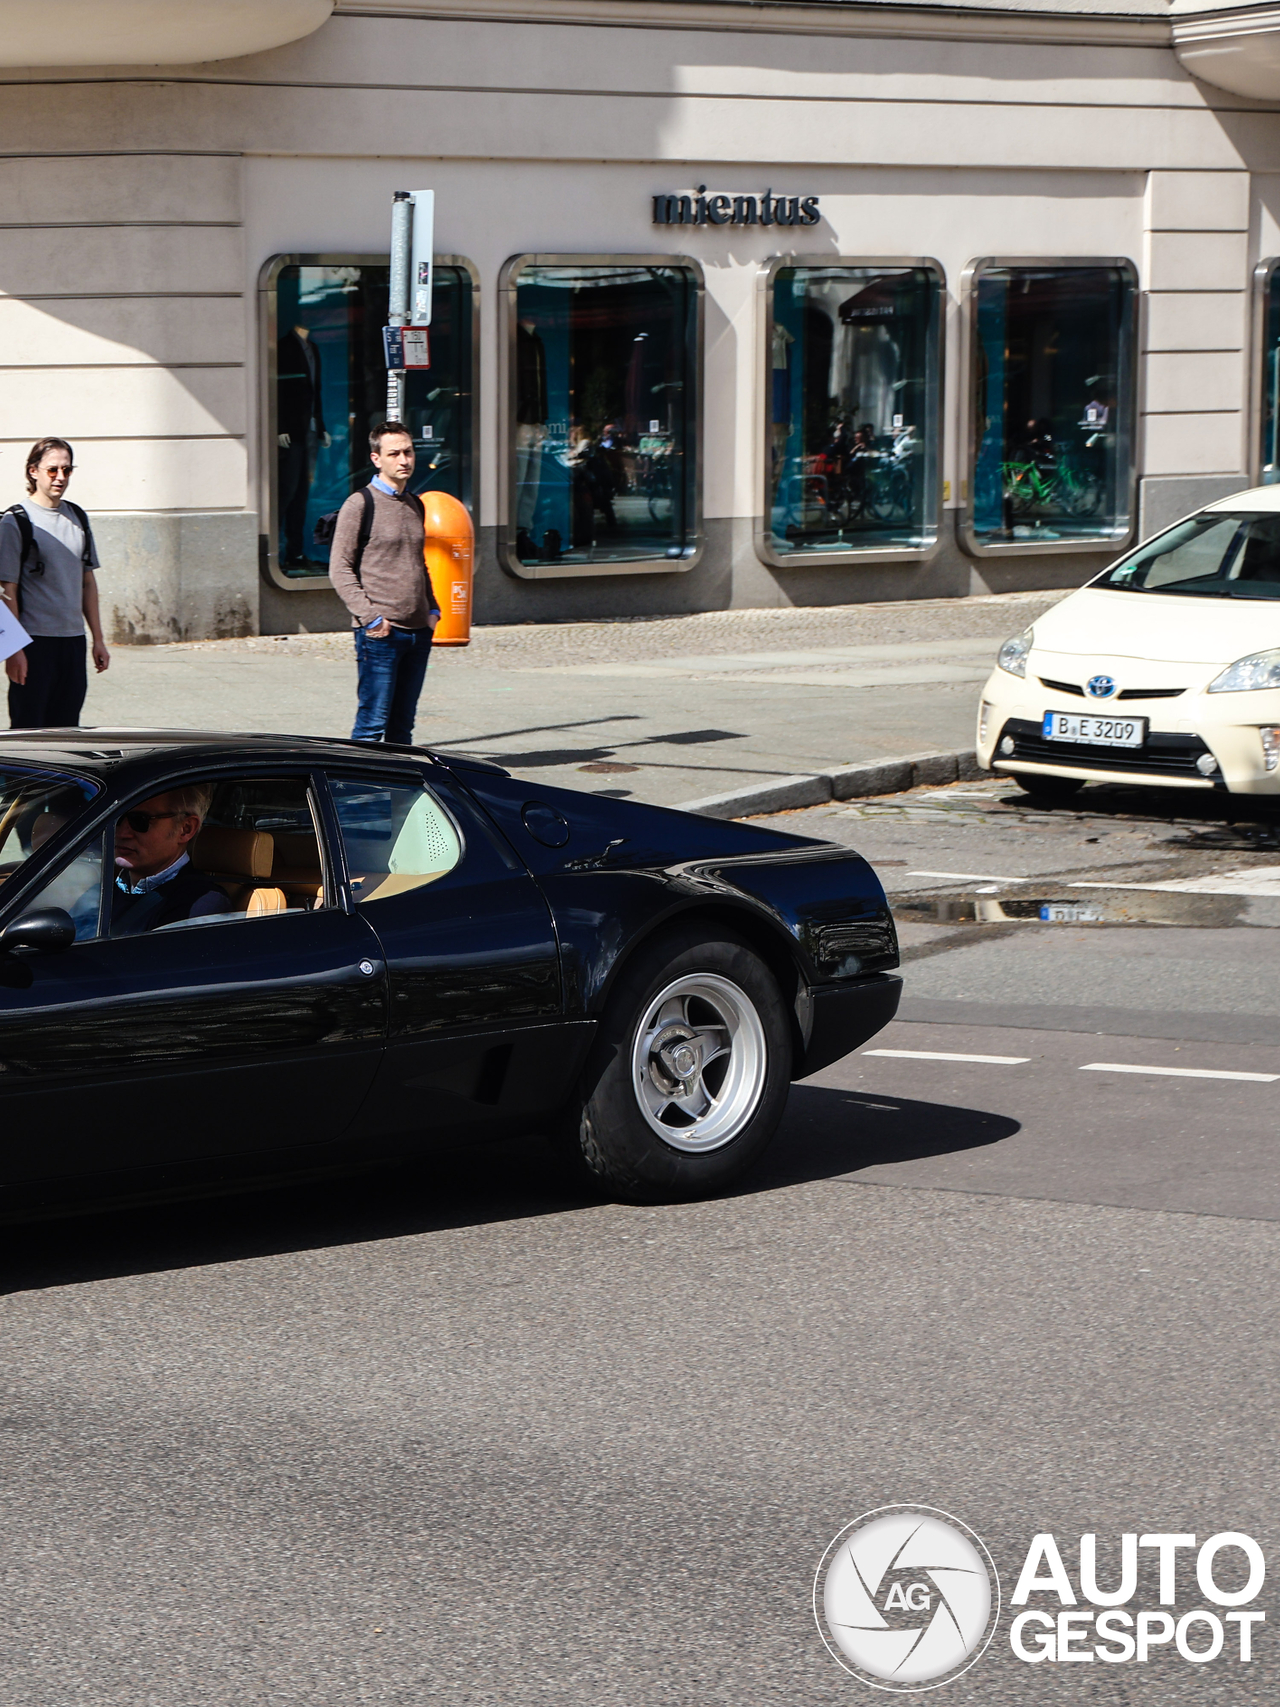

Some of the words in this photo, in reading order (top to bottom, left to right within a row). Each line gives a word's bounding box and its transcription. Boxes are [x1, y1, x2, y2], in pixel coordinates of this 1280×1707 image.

[652, 185, 821, 226] mientus
[1059, 717, 1069, 734] B
[1079, 719, 1090, 736] E
[1093, 720, 1134, 740] 3209
